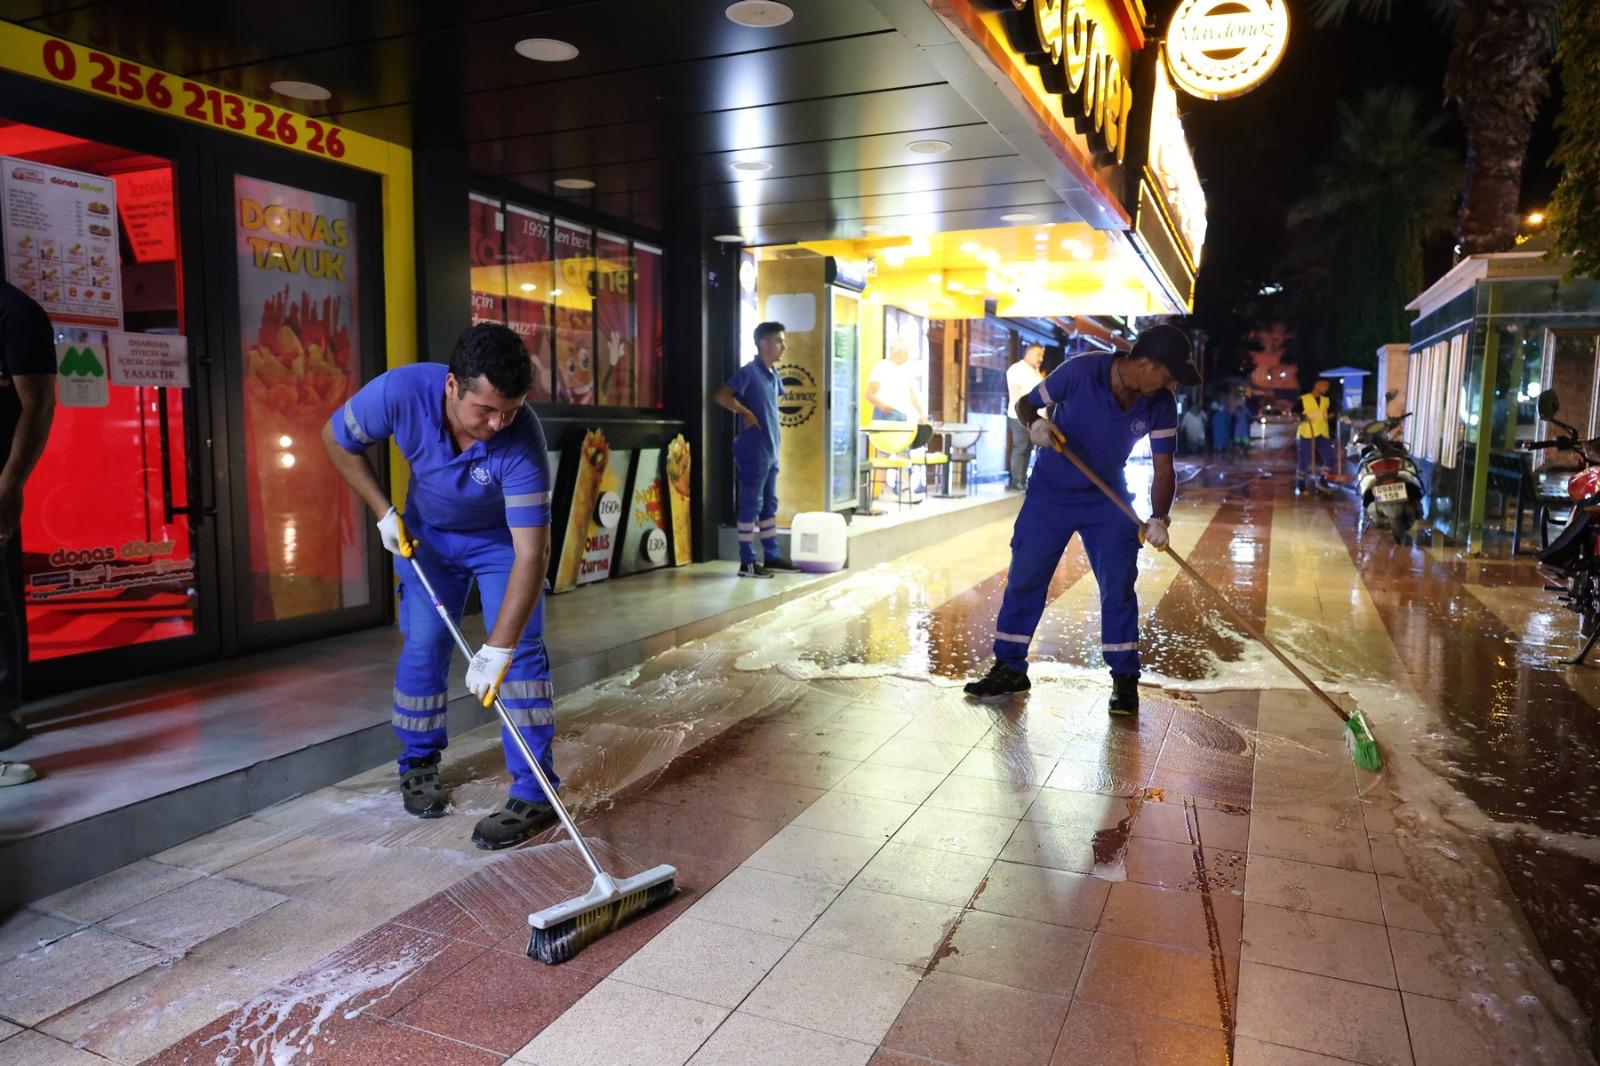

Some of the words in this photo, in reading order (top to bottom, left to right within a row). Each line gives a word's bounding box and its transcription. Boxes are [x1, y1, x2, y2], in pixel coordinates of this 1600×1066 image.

[43, 39, 77, 81] 0
[89, 53, 173, 109] 256
[182, 82, 246, 131] 213
[254, 104, 298, 145] 26
[305, 120, 346, 158] 26
[240, 199, 349, 248] DONAS
[247, 237, 346, 281] TAVUK
[51, 547, 115, 566] donas
[584, 534, 610, 552] ONAS
